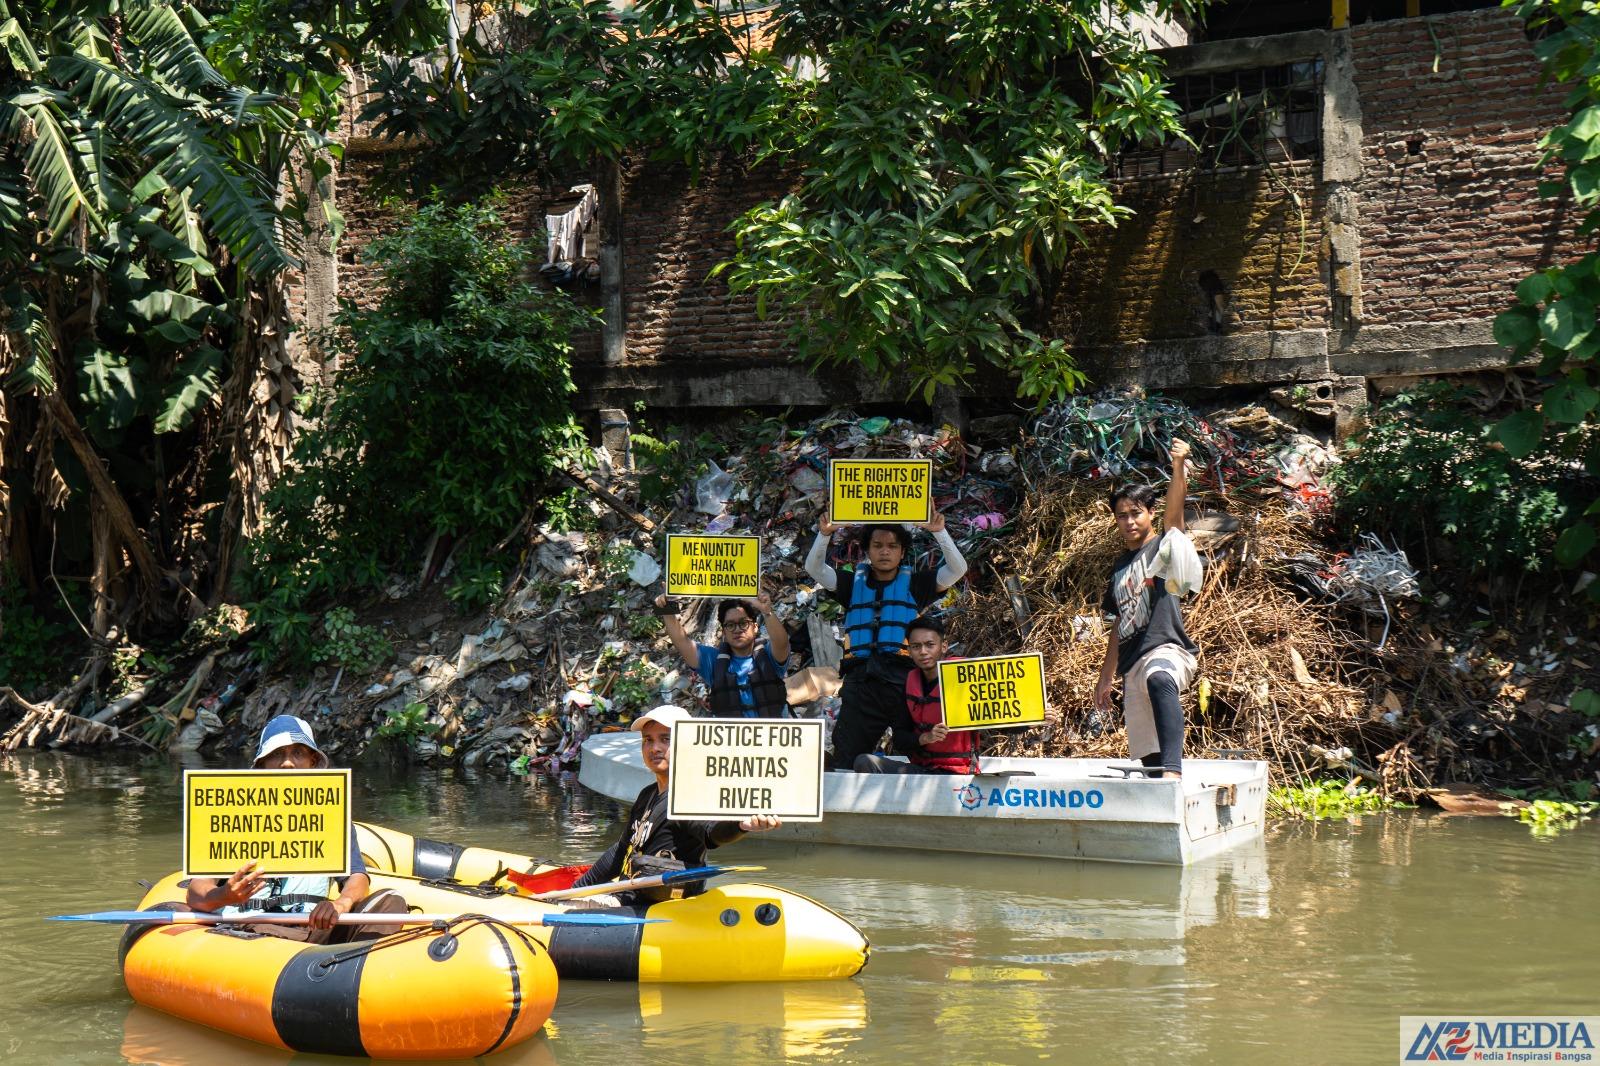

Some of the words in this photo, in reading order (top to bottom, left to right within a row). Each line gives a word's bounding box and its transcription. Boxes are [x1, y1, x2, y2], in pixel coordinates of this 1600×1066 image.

[837, 468, 860, 482] THE
[864, 468, 908, 482] RIGHTS
[911, 468, 926, 482] OF
[840, 484, 863, 499] THE
[867, 485, 922, 499] BRANTAS
[863, 501, 898, 515] RIVER
[682, 542, 745, 557] MENUNTUT
[691, 559, 712, 572] HAK
[715, 560, 736, 572] HAK
[670, 573, 707, 586] SUNGAI
[710, 574, 757, 587] BRANTAS
[957, 660, 1025, 683] BRANTAS
[969, 681, 1016, 702] SEGER
[968, 701, 1021, 721] WARAS
[693, 725, 763, 747] JUSTICE
[769, 726, 802, 747] FOR
[706, 756, 788, 778] BRANTAS
[194, 787, 278, 807] BEBASKAN
[283, 787, 341, 805] SUNGAI
[719, 787, 772, 808] RIVER
[988, 788, 1104, 808] AGRINDO
[210, 814, 283, 833] BRANTAS
[288, 813, 325, 832] DARI
[209, 840, 325, 860] MIKROPLASTIK
